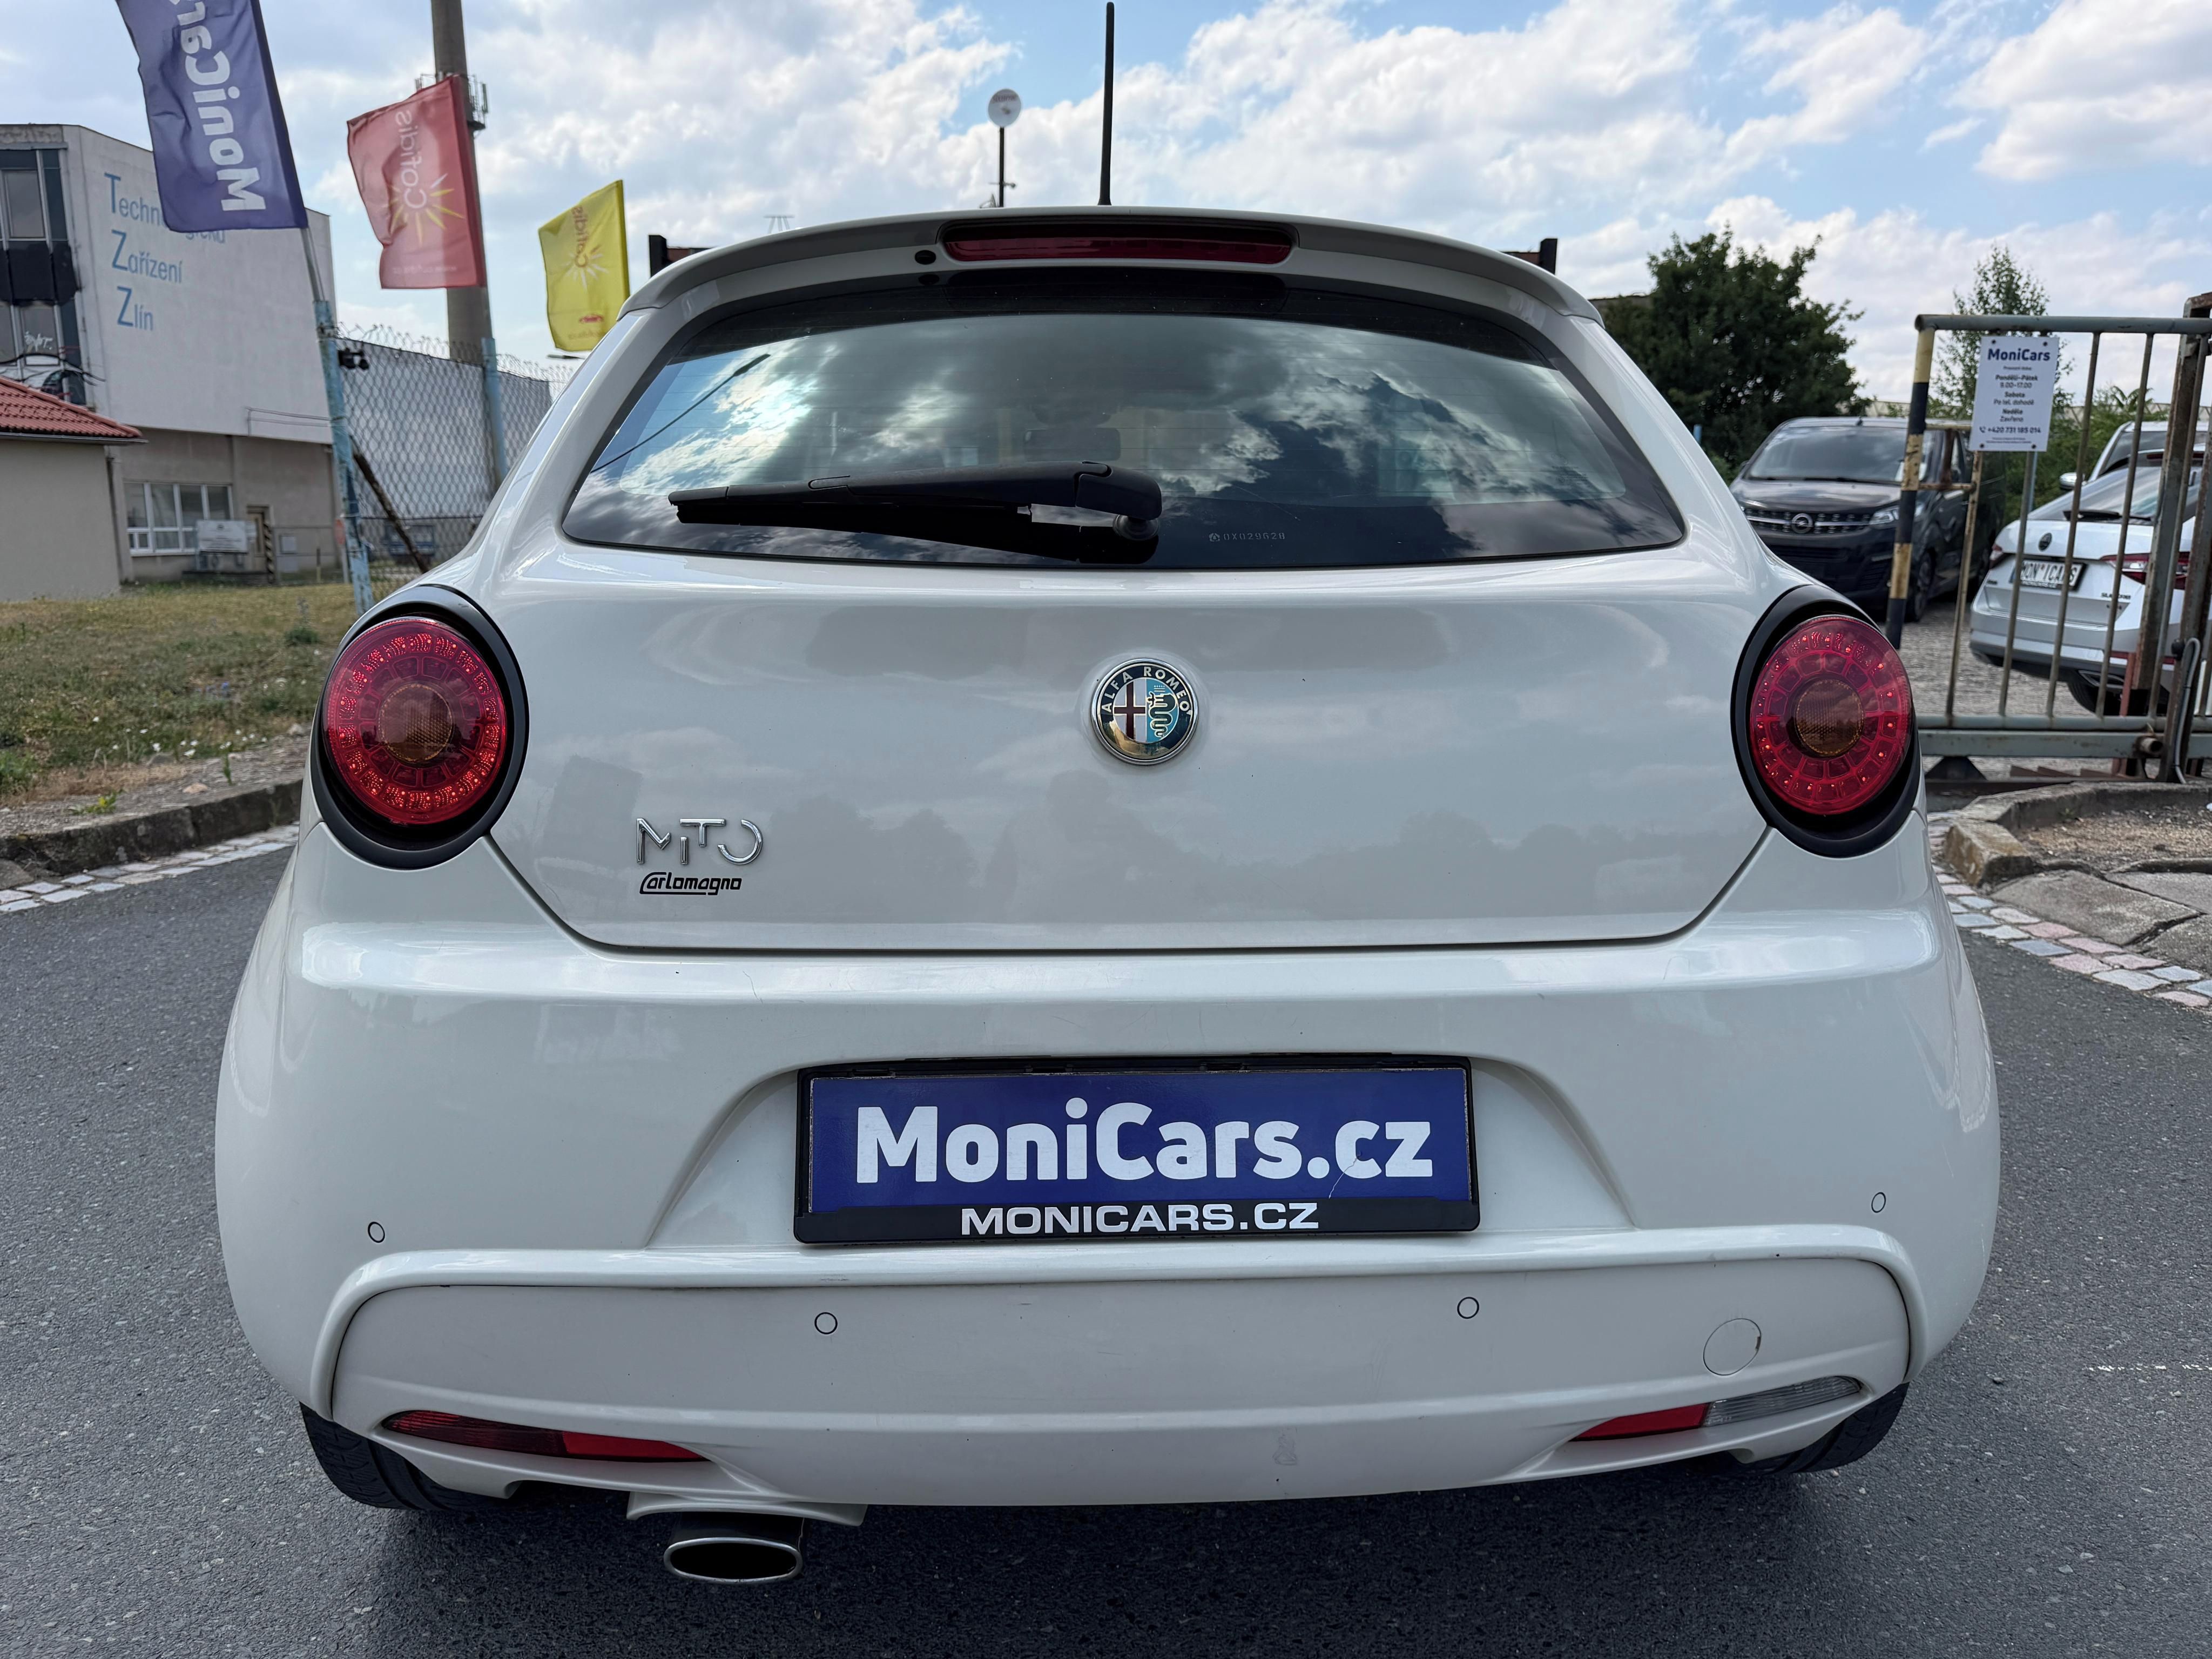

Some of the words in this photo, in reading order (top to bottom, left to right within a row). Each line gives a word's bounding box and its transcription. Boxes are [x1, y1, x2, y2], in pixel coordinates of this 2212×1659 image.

[111, 228, 183, 284] Zařízení
[117, 285, 154, 331] Zlín
[1988, 348, 2051, 361] MoniCars
[1101, 672, 1133, 713] ALFA
[1143, 666, 1191, 712] ROMEO
[639, 872, 742, 895] Carlomagno
[857, 1097, 1432, 1183] MoniCars.cz
[961, 1202, 1319, 1236] MONICARS.CZ
